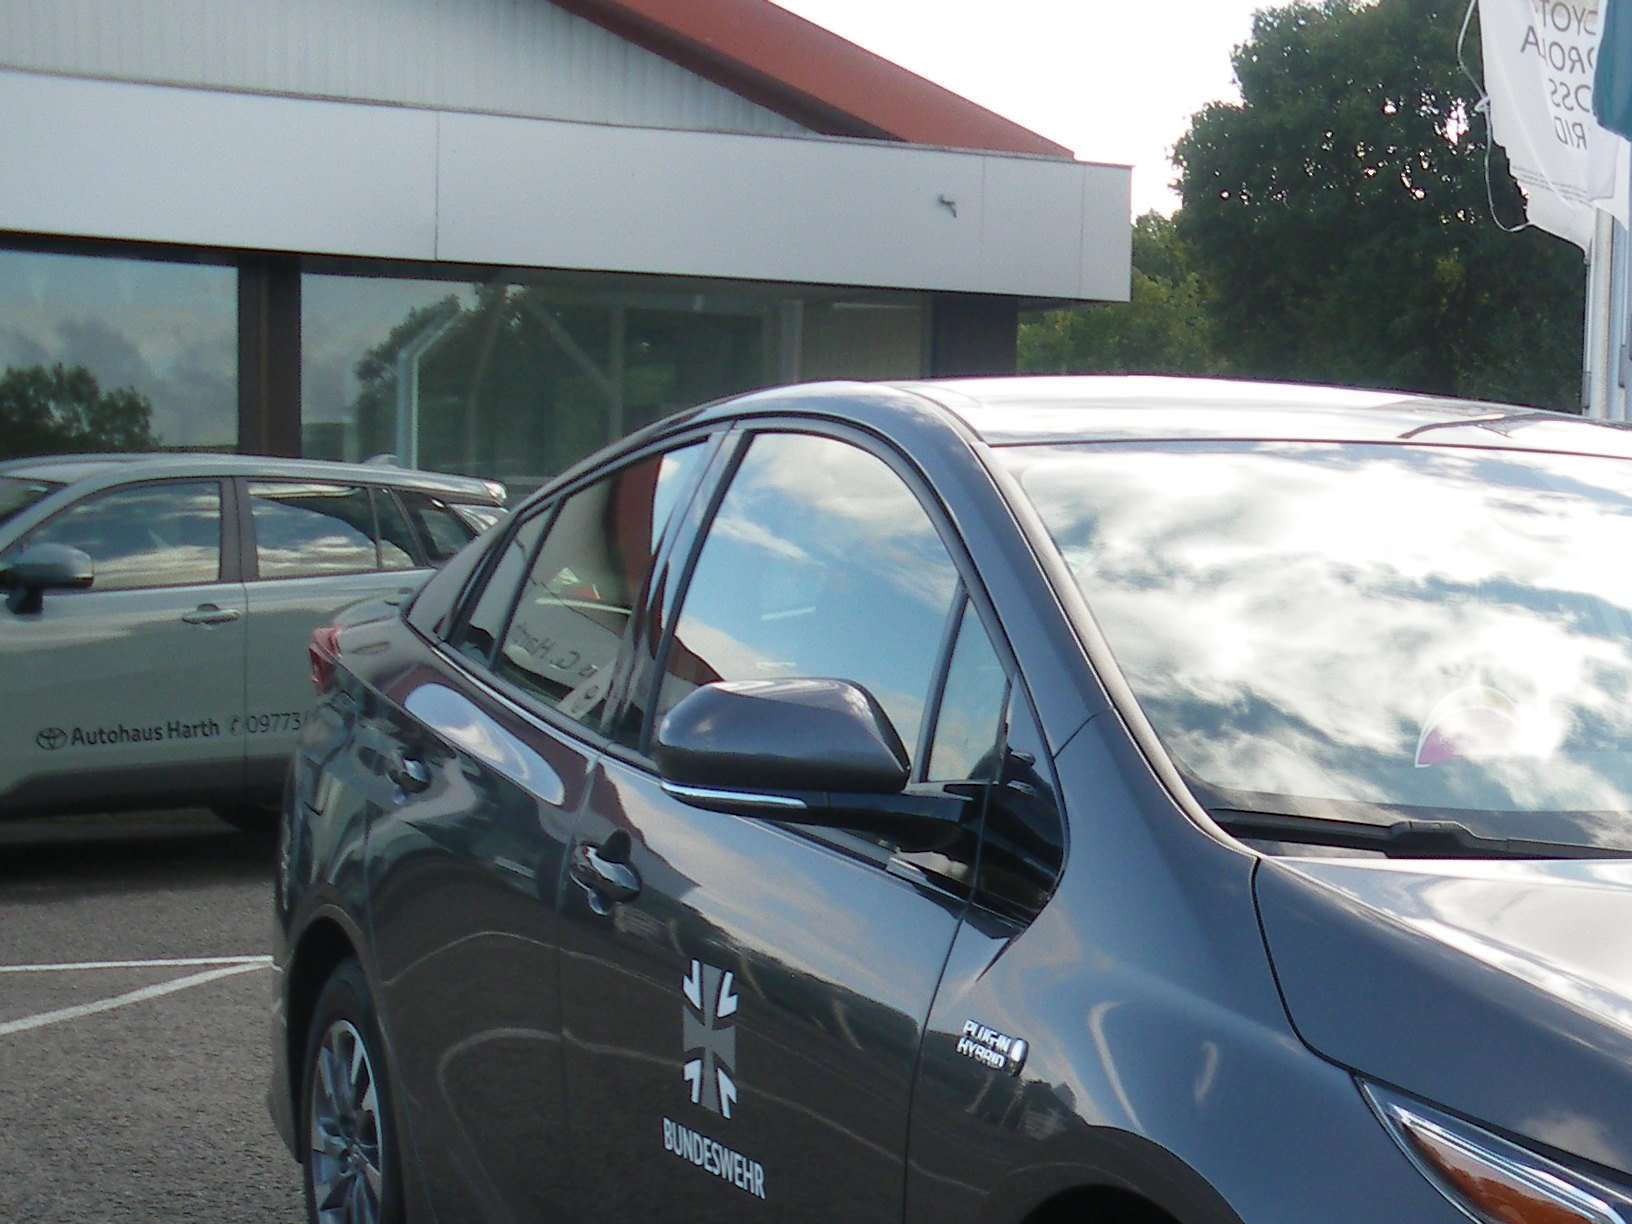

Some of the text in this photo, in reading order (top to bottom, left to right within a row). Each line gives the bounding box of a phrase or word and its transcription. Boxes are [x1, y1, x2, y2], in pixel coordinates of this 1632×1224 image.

[71, 724, 163, 747] Autohaus
[167, 718, 220, 740] Harth
[956, 1036, 1005, 1068] HYBRID
[663, 1117, 766, 1200] BUNDESWEHR
